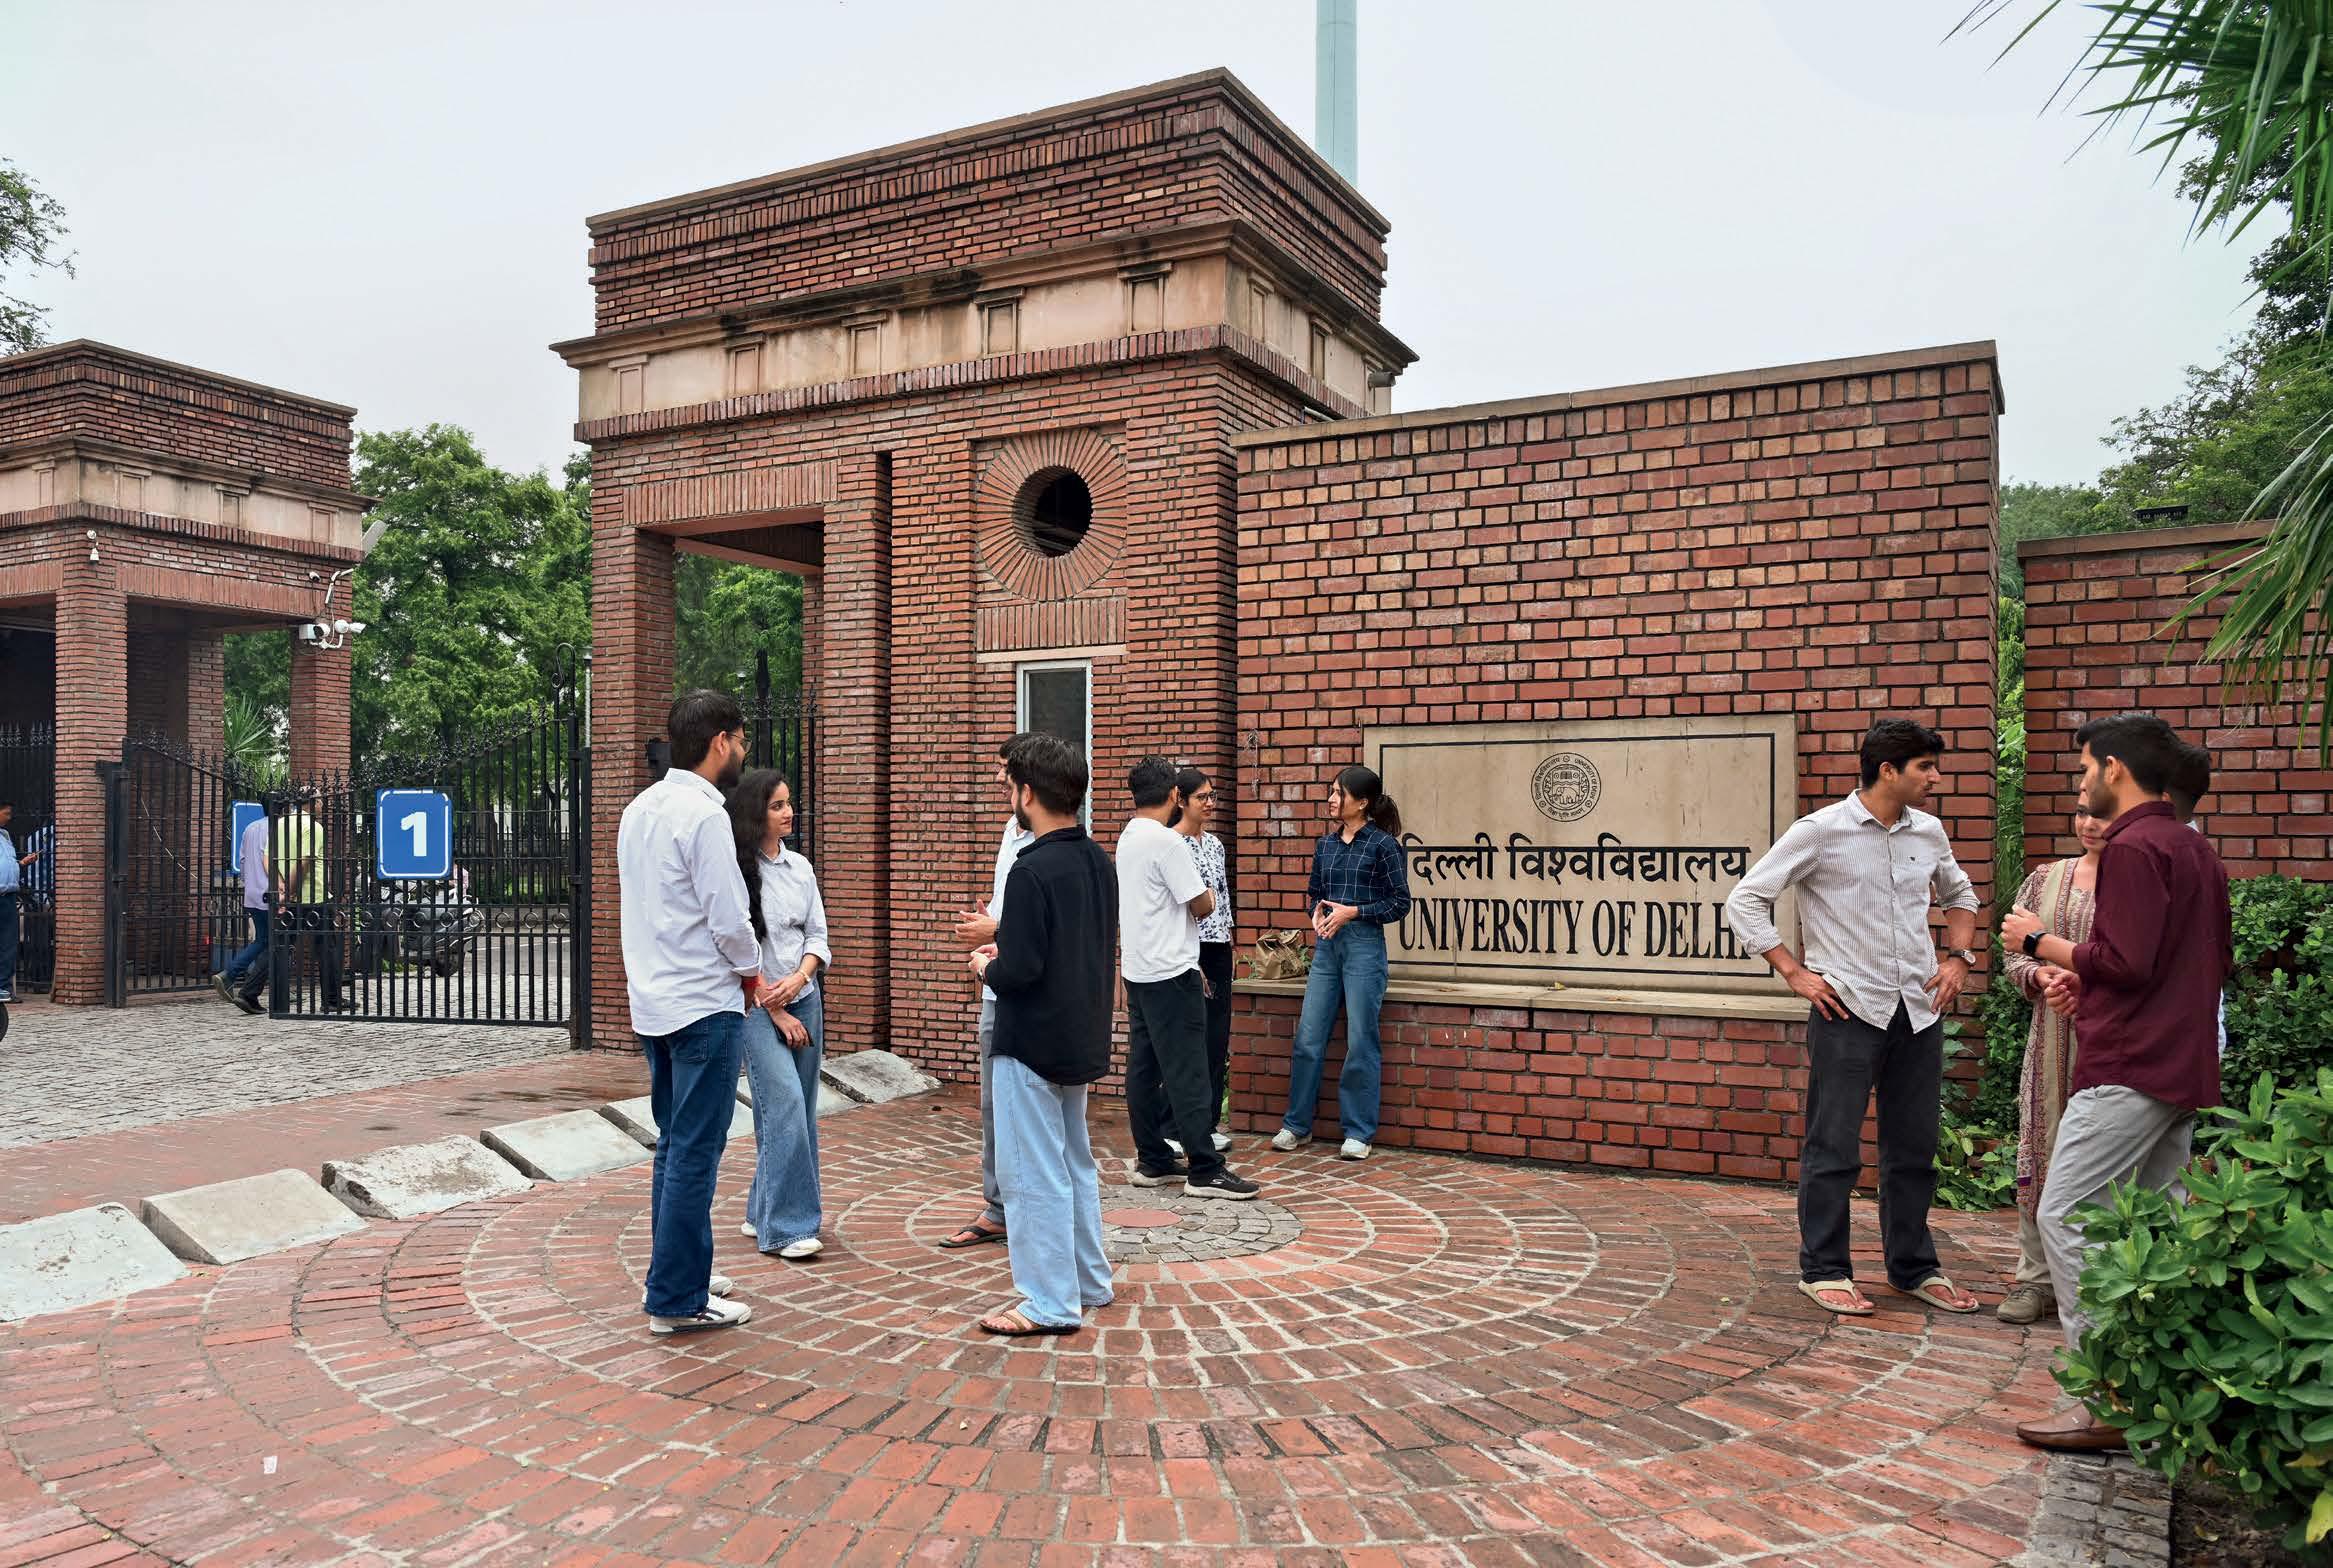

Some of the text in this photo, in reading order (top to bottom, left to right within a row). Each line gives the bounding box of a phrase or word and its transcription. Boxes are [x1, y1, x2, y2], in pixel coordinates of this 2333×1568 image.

[401, 811, 427, 857] 1
[1400, 832, 1752, 885] दिल्ली विश्वविद्यालय
[1399, 897, 1751, 960] UNIVERSITY OF DELH
